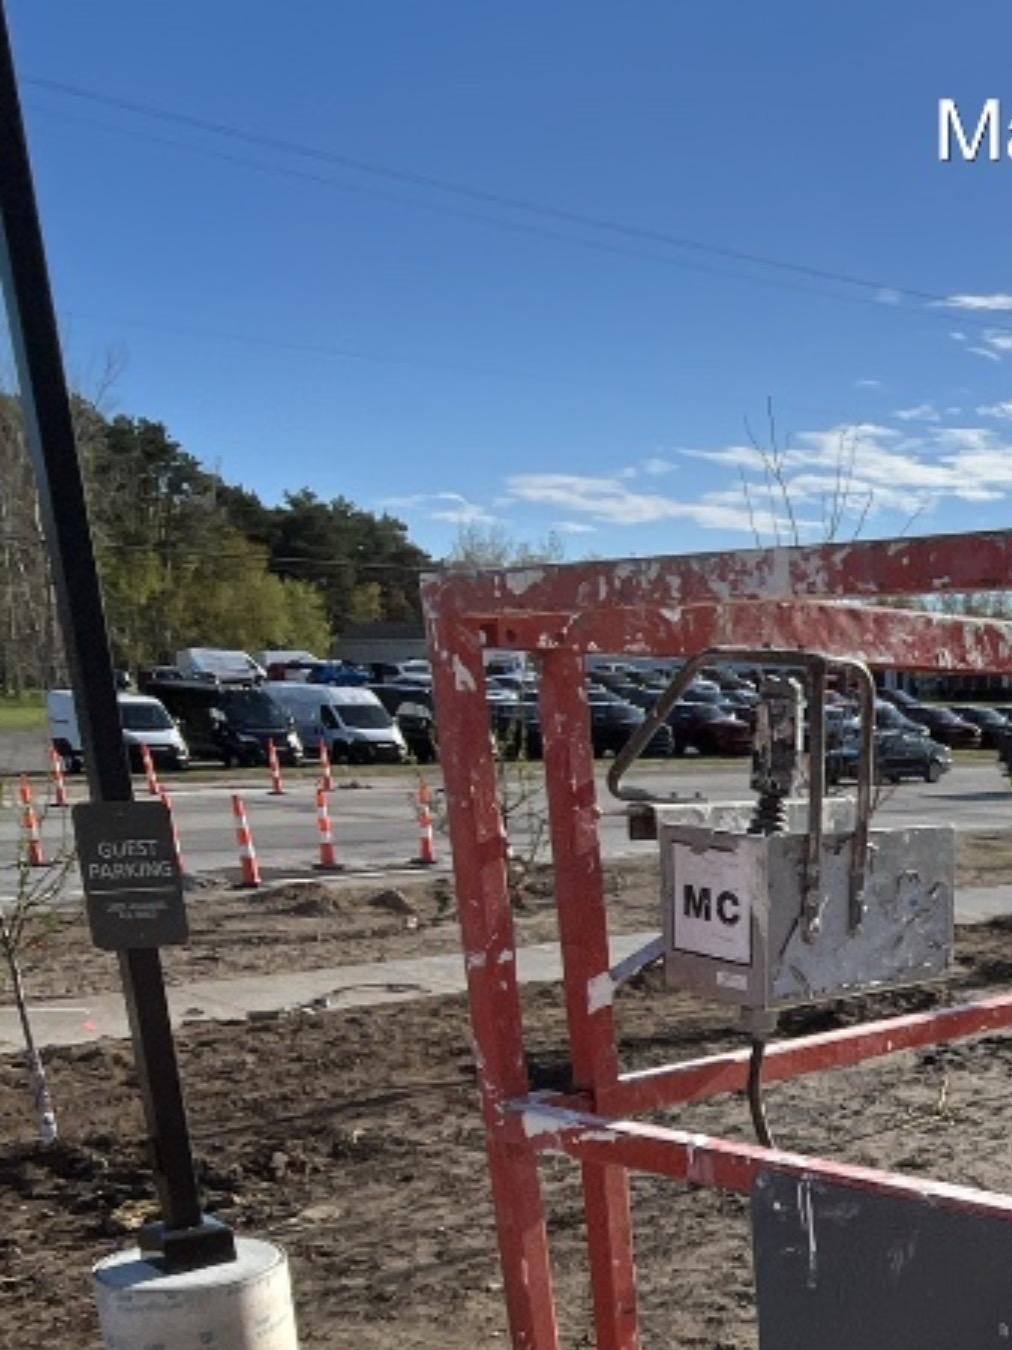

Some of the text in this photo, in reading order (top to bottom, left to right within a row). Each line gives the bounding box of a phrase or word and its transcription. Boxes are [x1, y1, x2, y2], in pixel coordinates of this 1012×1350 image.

[98, 839, 158, 859] GUEST
[88, 861, 173, 880] PARKING
[683, 884, 741, 926] MC
